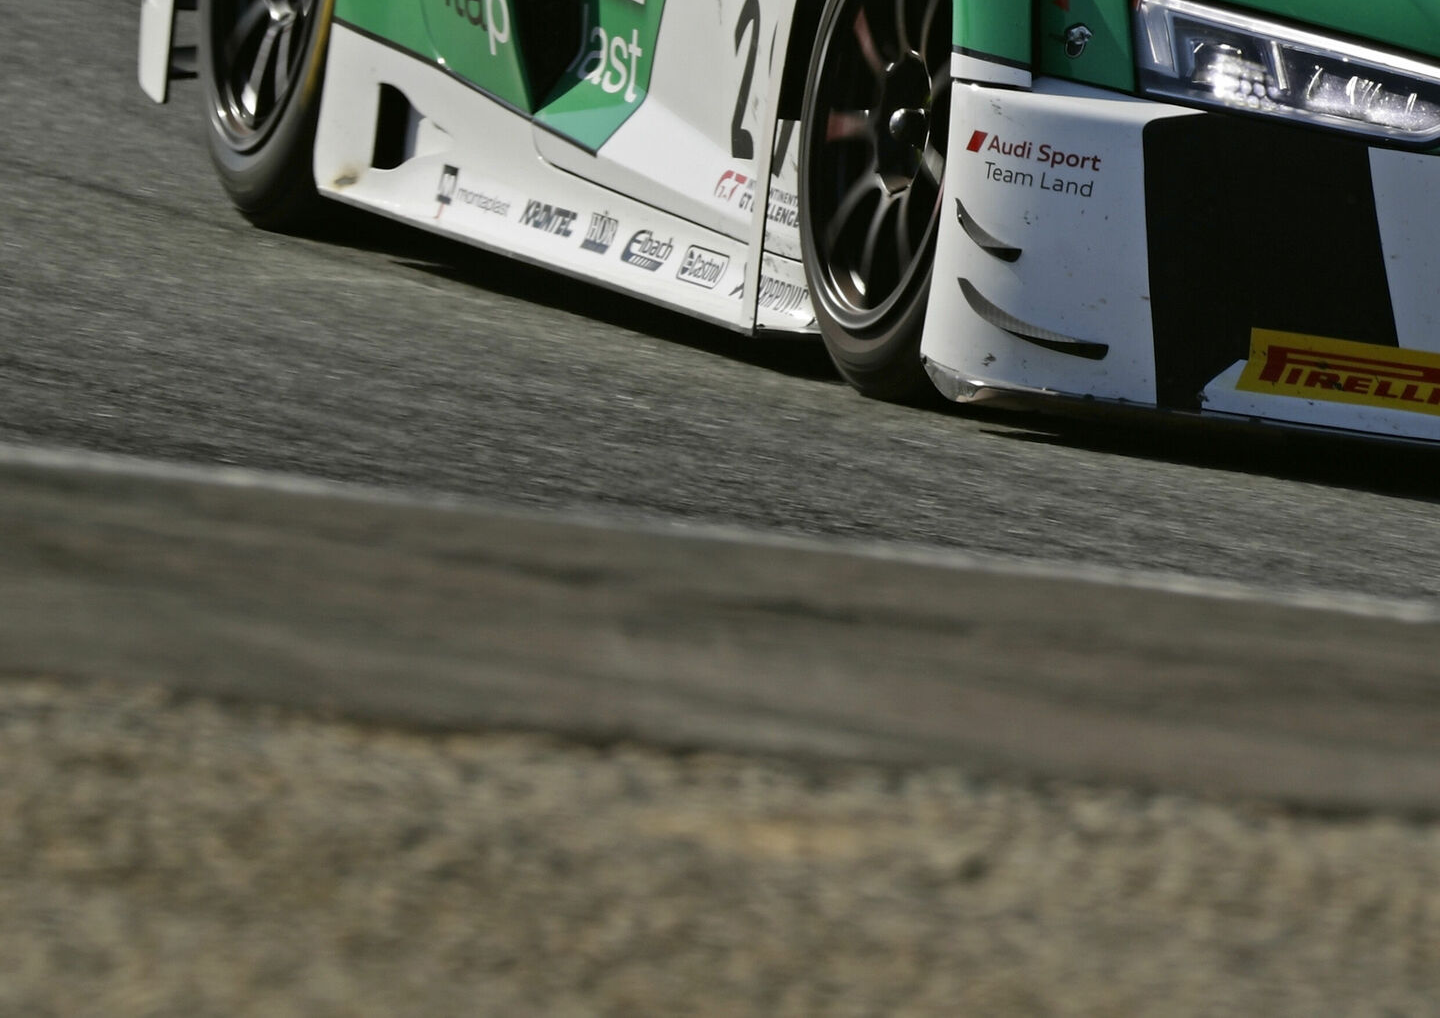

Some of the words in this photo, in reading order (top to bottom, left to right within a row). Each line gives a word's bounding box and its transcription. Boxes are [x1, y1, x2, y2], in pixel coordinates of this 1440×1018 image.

[987, 135, 1033, 160] Audi
[1037, 144, 1102, 172] Sport
[985, 161, 1034, 188] Team
[1040, 172, 1095, 198] Land
